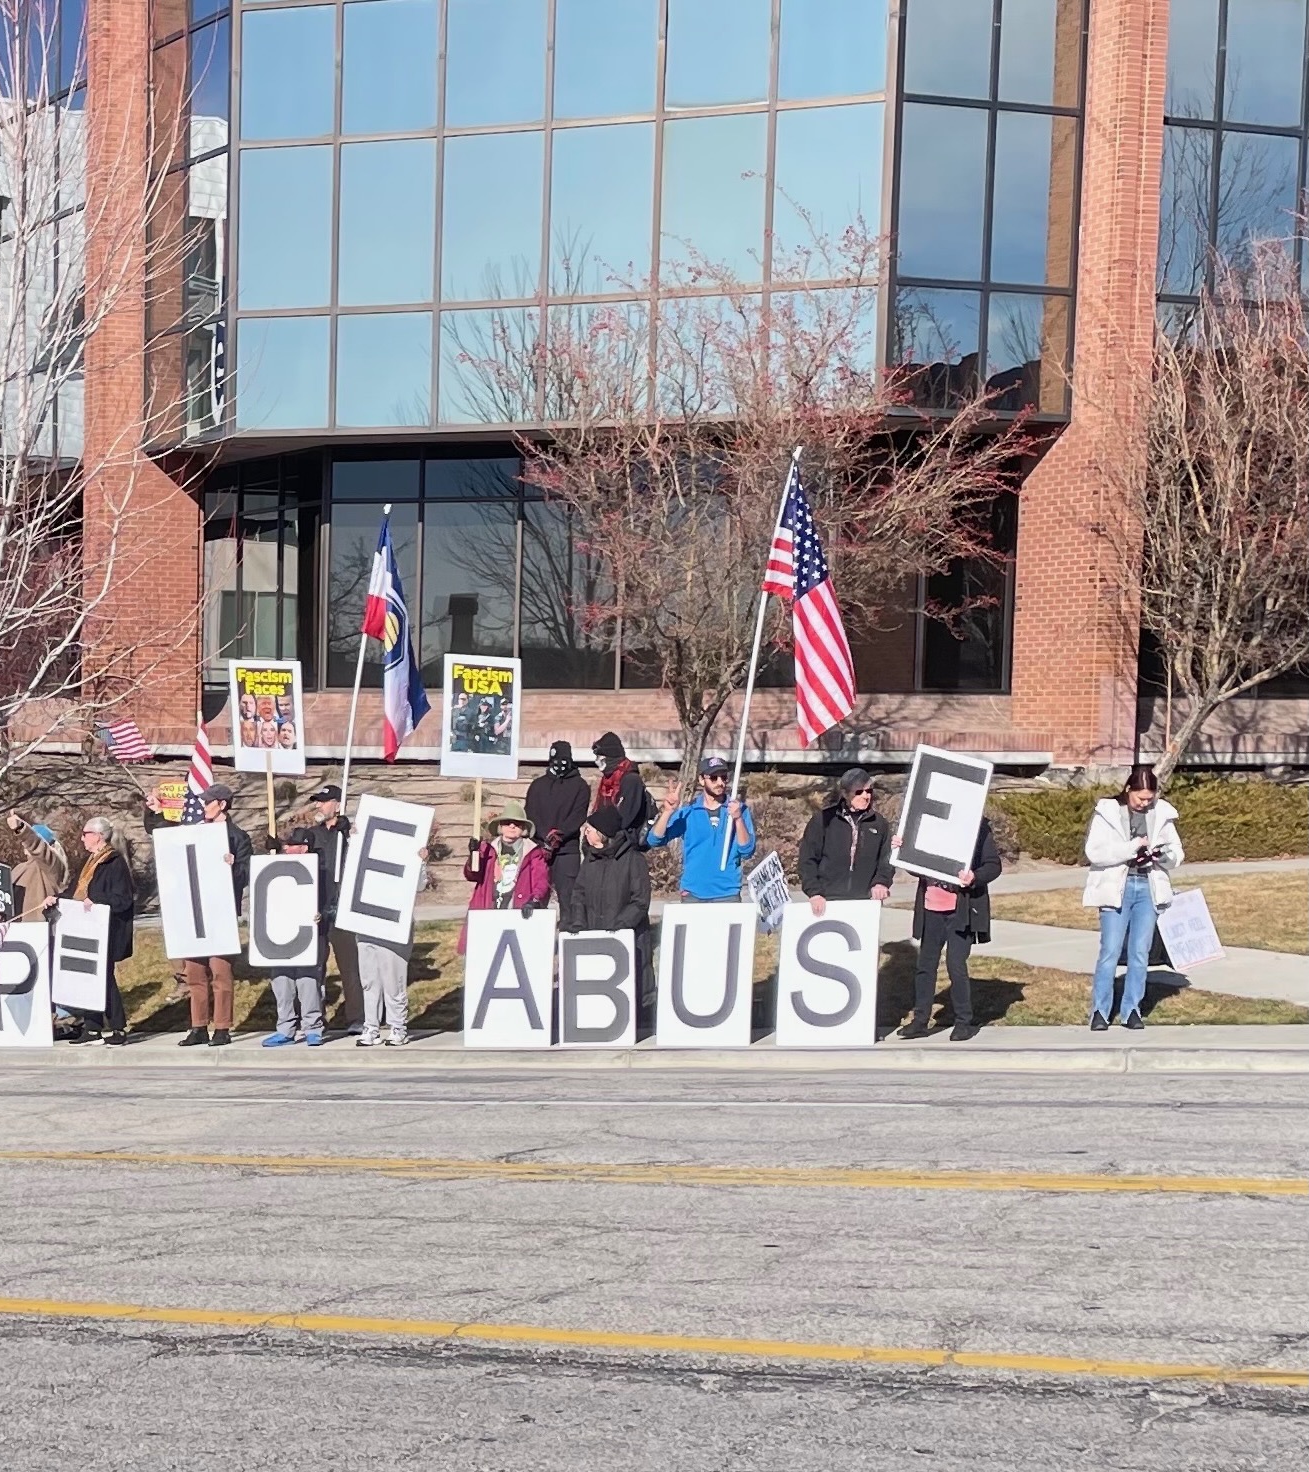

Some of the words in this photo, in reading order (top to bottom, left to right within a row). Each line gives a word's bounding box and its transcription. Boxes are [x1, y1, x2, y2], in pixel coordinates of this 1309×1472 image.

[237, 668, 292, 684] Fascism
[453, 664, 513, 683] Fascism
[245, 681, 286, 696] Faces
[463, 678, 503, 697] USA
[185, 815, 418, 960] ICE
[471, 752, 988, 1046] ABUSE
